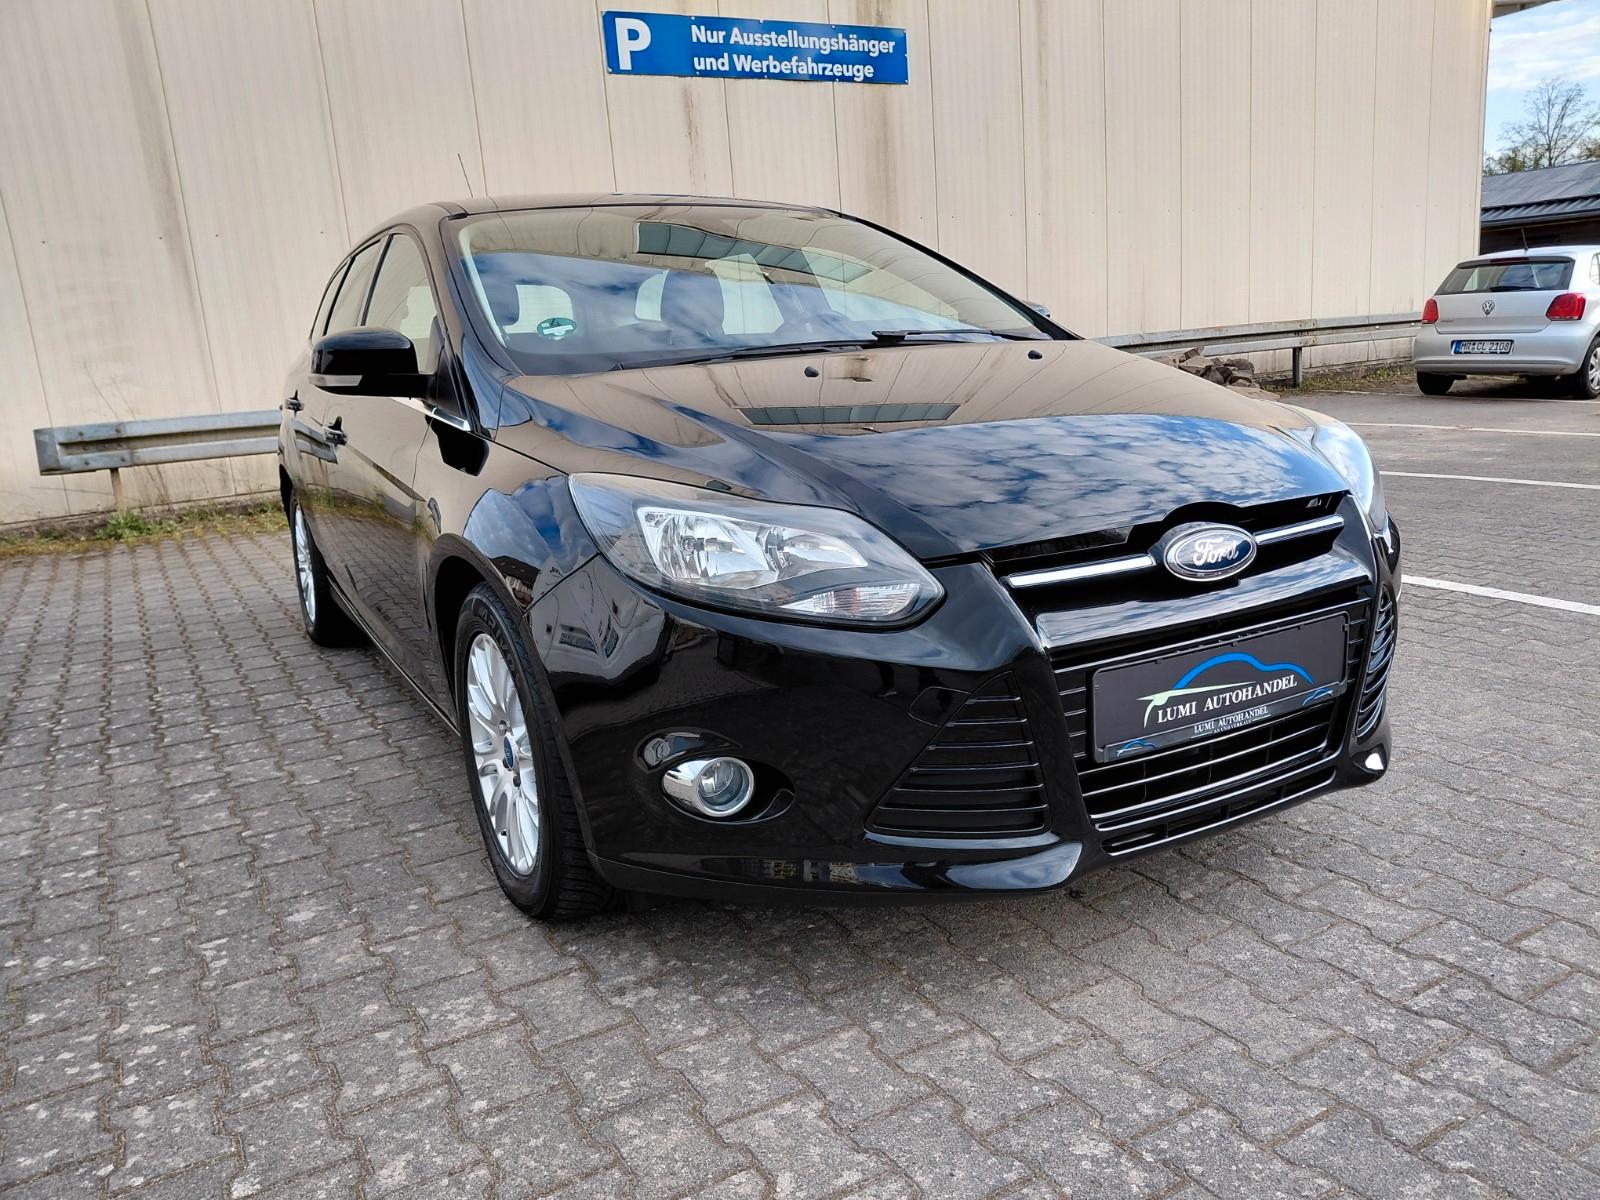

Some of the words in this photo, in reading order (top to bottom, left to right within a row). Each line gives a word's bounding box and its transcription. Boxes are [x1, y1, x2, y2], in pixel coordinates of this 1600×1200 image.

[614, 17, 651, 70] P
[691, 25, 726, 45] Nur
[729, 28, 895, 57] Ausstellungshänger
[693, 52, 729, 72] und
[733, 54, 874, 82] Werbefahrzeuge
[1192, 537, 1239, 566] Ford
[1157, 701, 1197, 724] LUMI
[1203, 674, 1297, 712] AUTOHANDEL
[1194, 720, 1215, 734] LUMI
[1217, 706, 1269, 728] AUTOHANDEL
